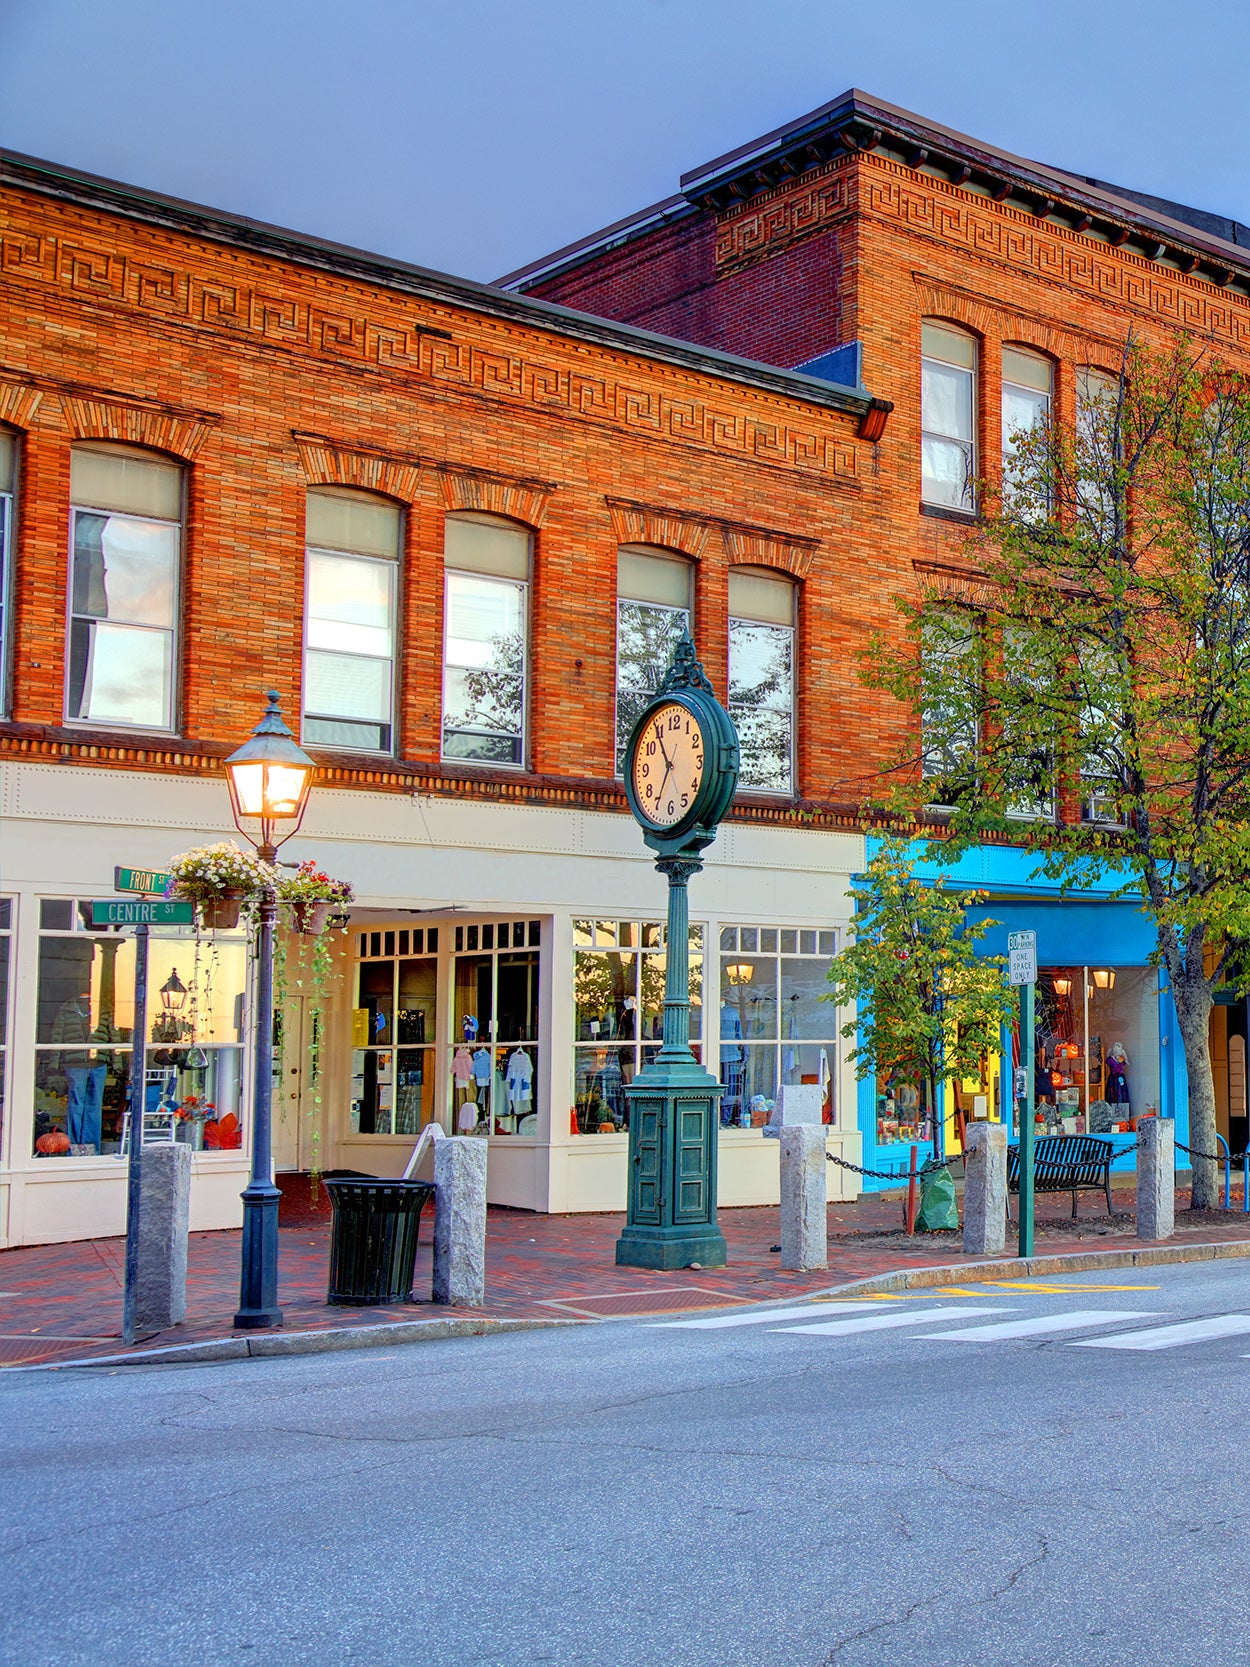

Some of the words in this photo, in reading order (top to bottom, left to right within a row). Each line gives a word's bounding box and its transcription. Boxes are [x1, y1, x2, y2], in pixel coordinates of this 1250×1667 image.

[668, 714, 681, 731] 12
[685, 720, 690, 735] 1
[646, 740, 656, 756] 10
[691, 733, 700, 749] 2
[696, 754, 704, 769] 3
[642, 763, 649, 778] 9
[646, 783, 653, 798] 8
[691, 777, 698, 792] 4
[654, 796, 661, 810] 7
[667, 800, 674, 815] 6
[680, 793, 688, 808] 5
[129, 871, 157, 891] FRONT
[158, 875, 165, 884] ST
[108, 903, 158, 922] CENTRE
[164, 904, 176, 914] ST
[1010, 935, 1017, 949] 30
[1016, 953, 1028, 961] ONE
[1013, 962, 1031, 970] SPACE
[1015, 972, 1030, 980] ONLY
